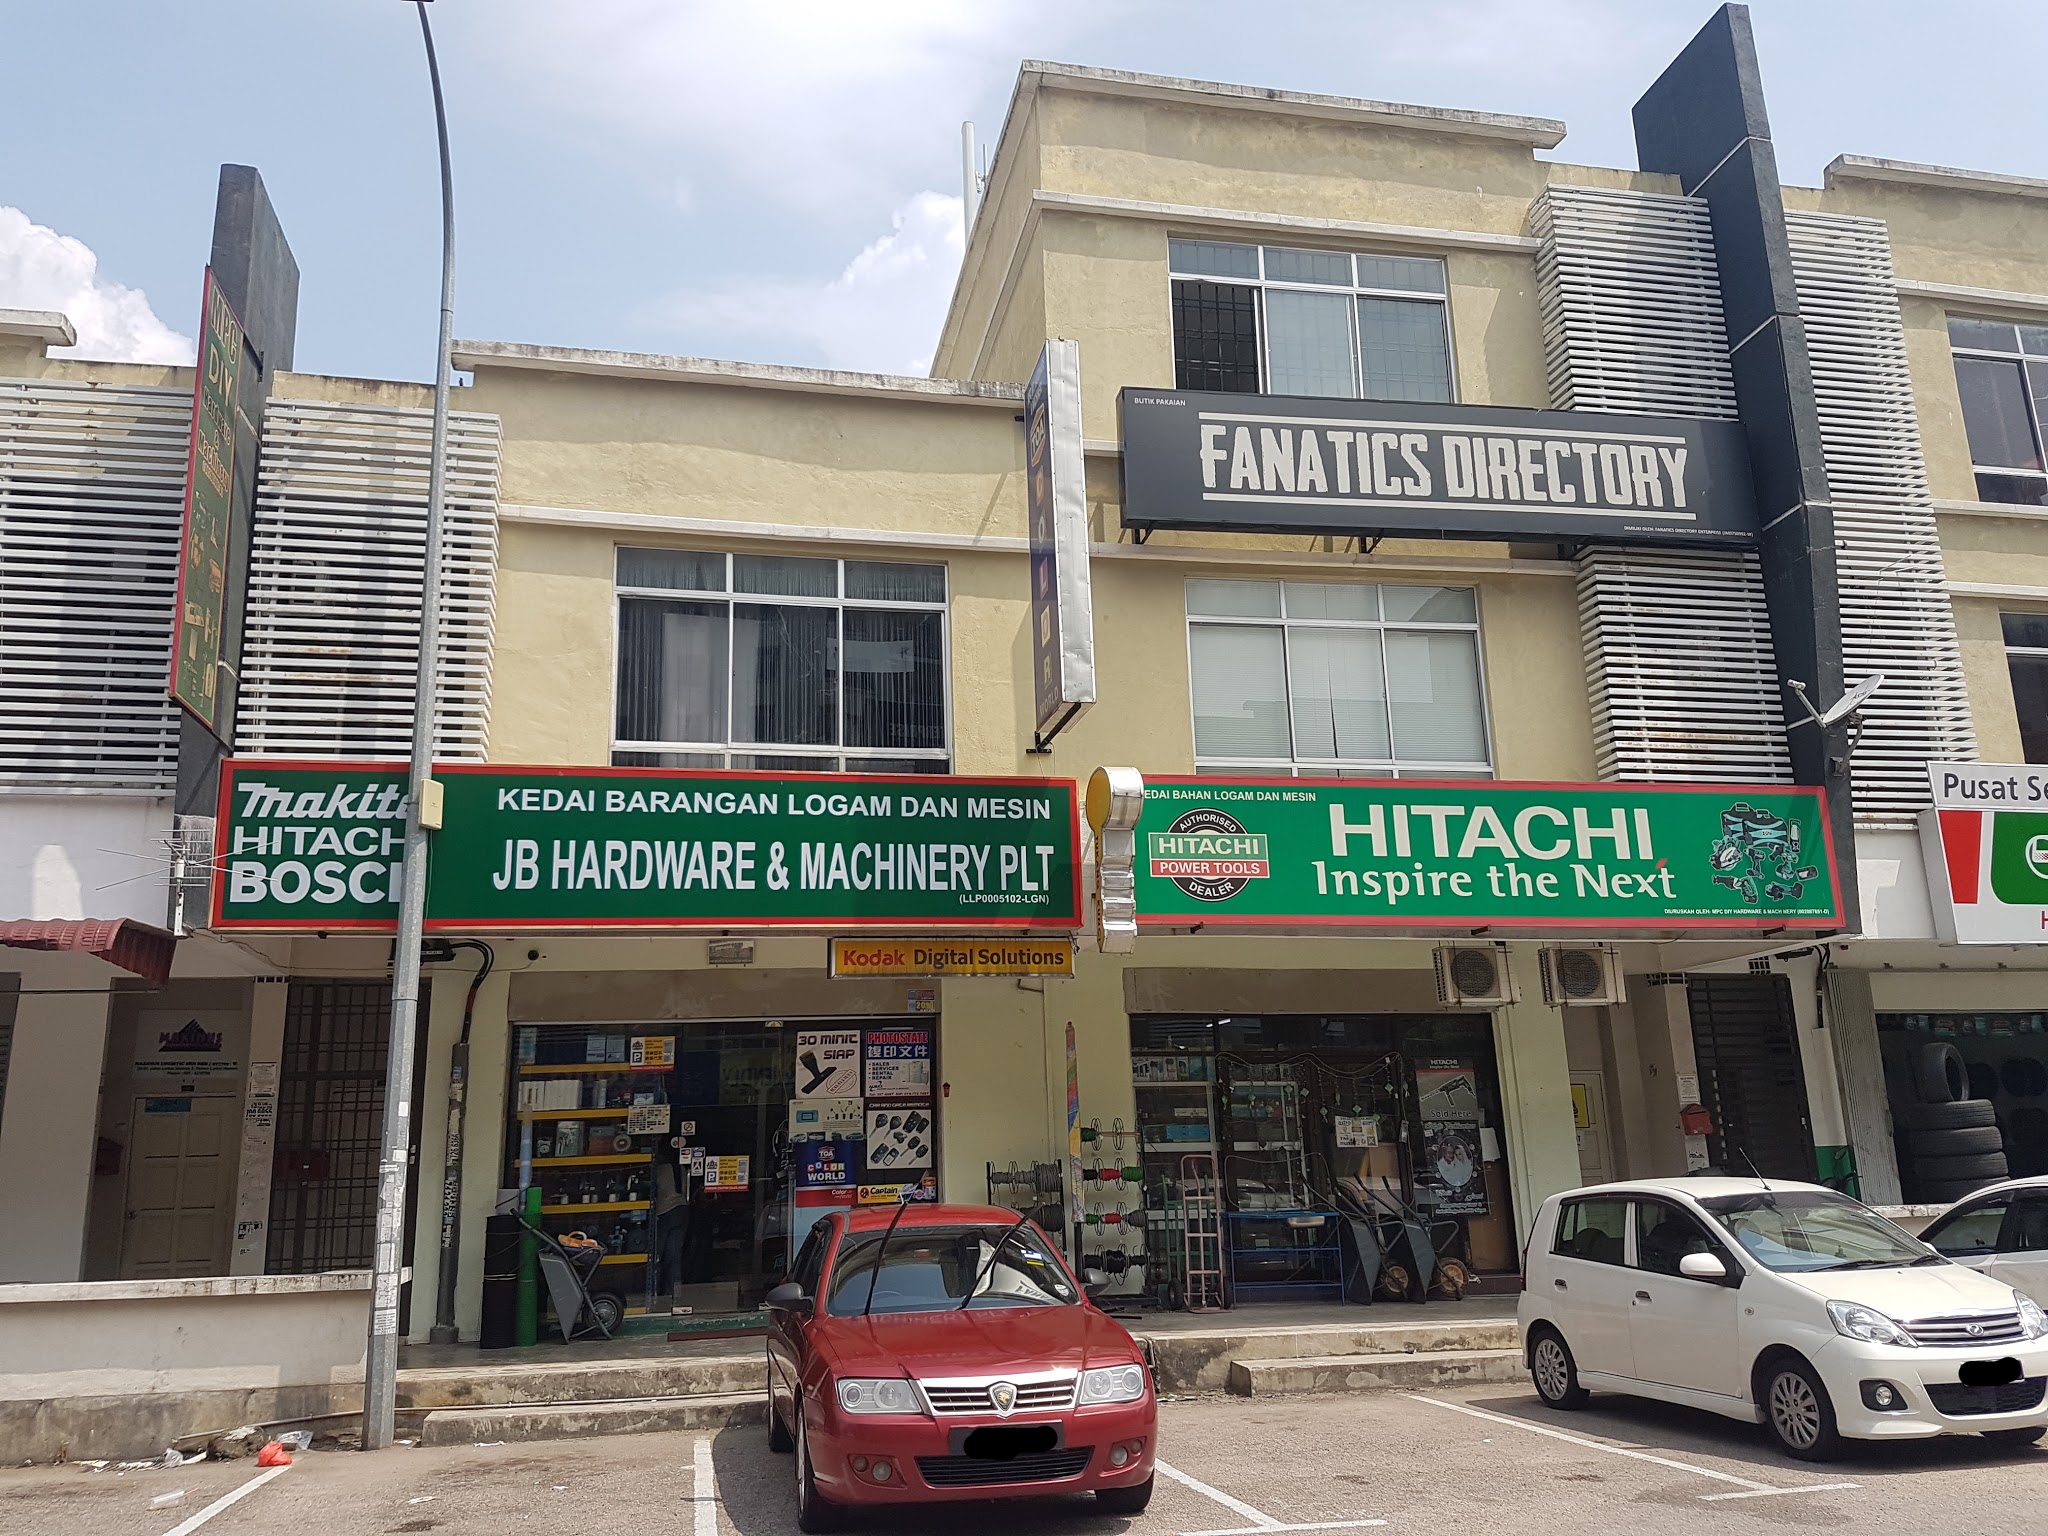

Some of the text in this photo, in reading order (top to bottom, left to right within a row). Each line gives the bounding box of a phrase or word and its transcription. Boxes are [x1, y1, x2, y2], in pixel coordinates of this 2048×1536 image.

[210, 285, 238, 364] MPC
[208, 342, 232, 407] DIY
[1134, 397, 1186, 407] BUTIK PAKAIAN
[1030, 417, 1045, 452] TOA
[1199, 424, 1688, 508] FANATICS DIRECTORY
[1144, 791, 1316, 801] EDAI BAHAN LOGAM DAN MESIN
[1944, 773, 2018, 801] Pusat
[498, 788, 1050, 819] KEDAI BARANGAN LOGAM DAN MESIN
[1179, 813, 1237, 832] AUTHORISED
[1329, 803, 1654, 860] HITACHI
[233, 825, 406, 856] HITACH
[1158, 837, 1260, 855] HITACHI
[492, 839, 1054, 891] JB HARDWARE & MACHINERY PLT
[1160, 861, 1260, 874] POWER TOOLS
[1188, 881, 1235, 897] DEALER
[1311, 859, 1677, 905] Inspire the Next
[959, 893, 1050, 905] (LLP0005102-LGN)
[843, 948, 1064, 969] Kodak Digital Solutions
[798, 1035, 817, 1045] 30
[868, 1032, 928, 1044] PHOTOSTATE
[824, 1049, 855, 1060] SIAP
[868, 1045, 928, 1058] 複印文件
[1430, 1109, 1471, 1118] Sold Here
[807, 1162, 845, 1172] COLOR
[807, 1172, 846, 1181] WORLD
